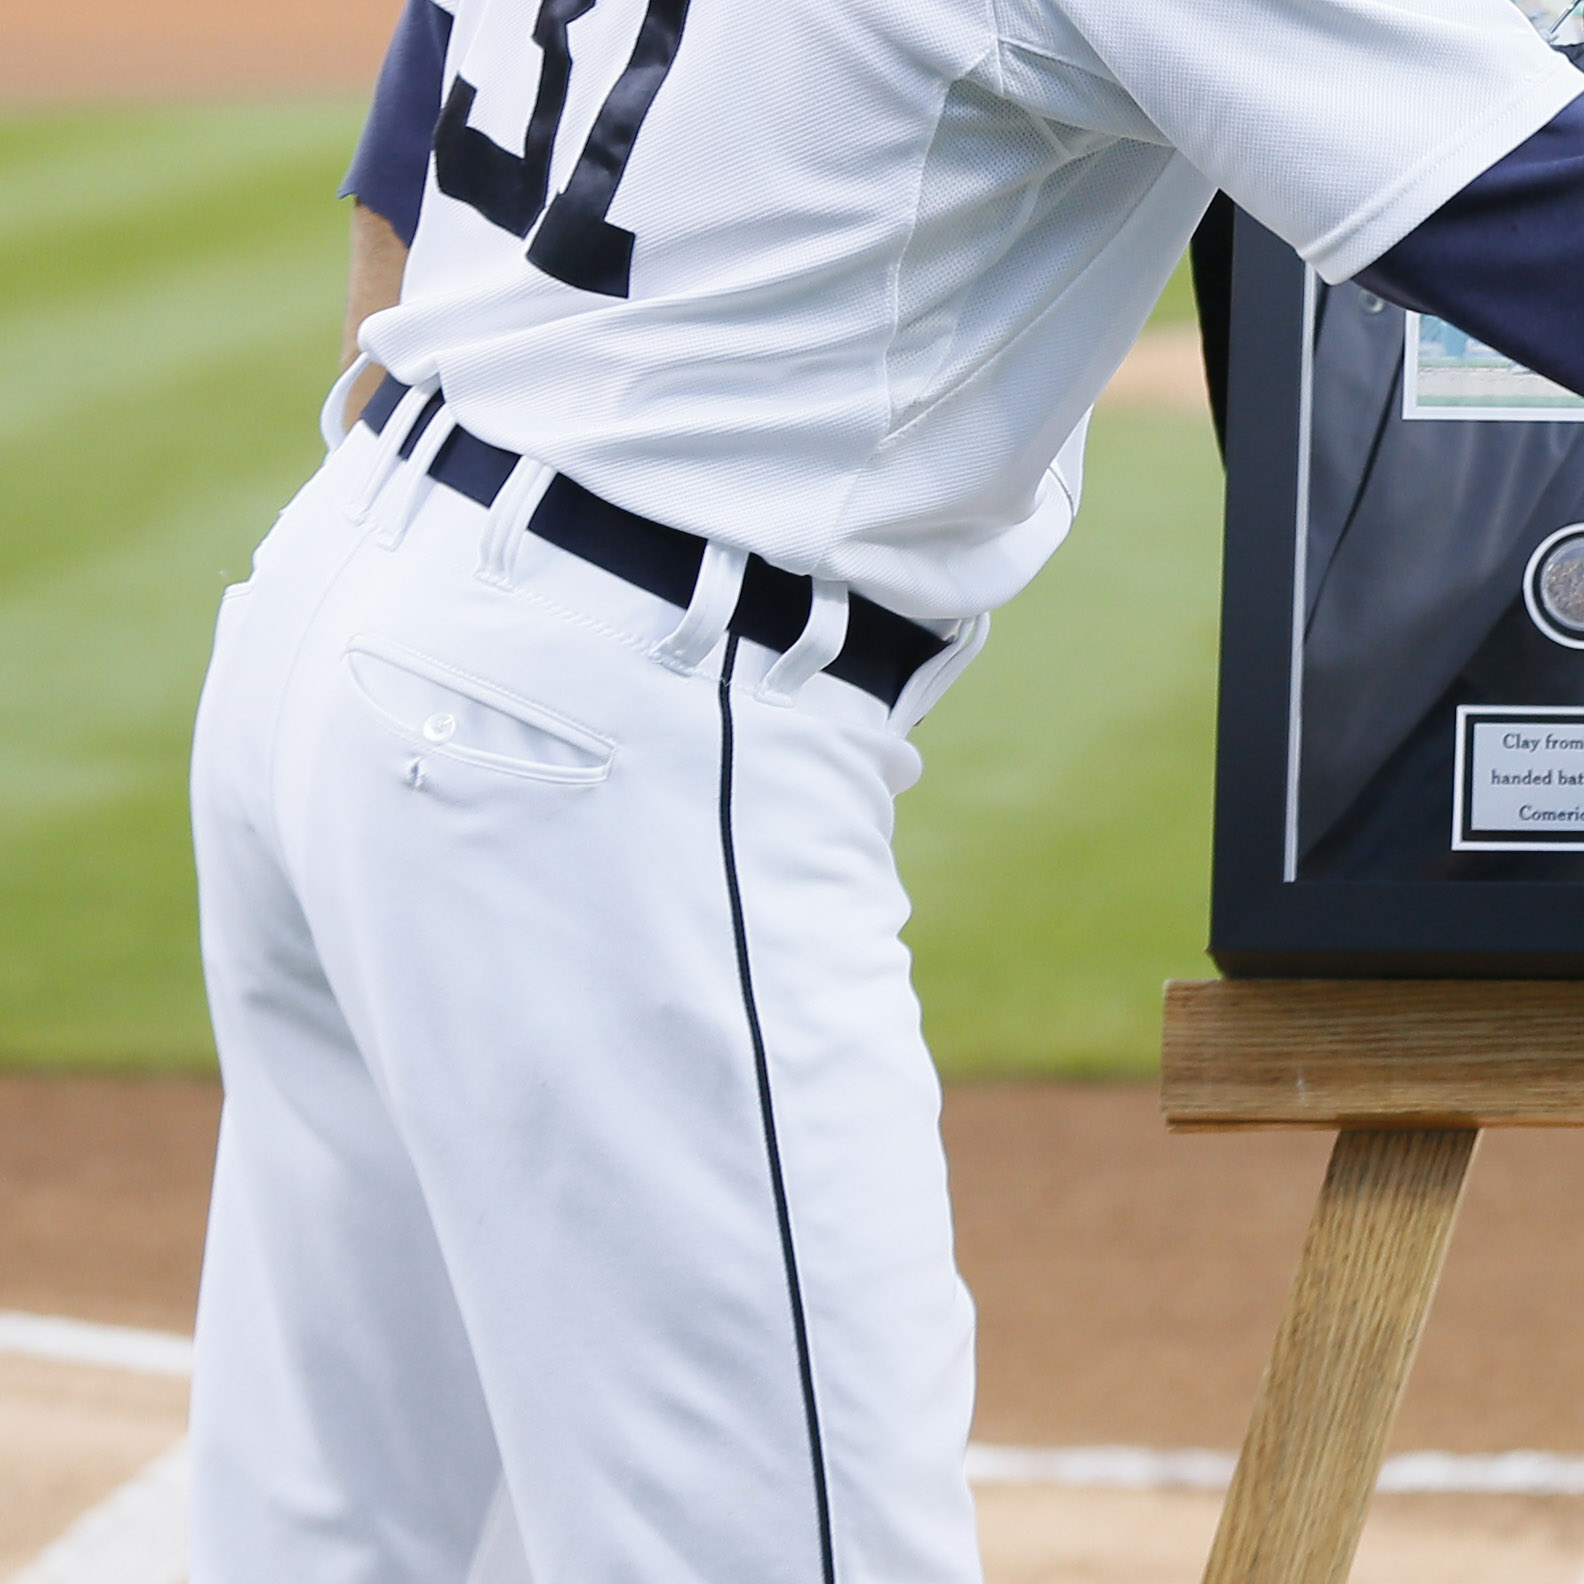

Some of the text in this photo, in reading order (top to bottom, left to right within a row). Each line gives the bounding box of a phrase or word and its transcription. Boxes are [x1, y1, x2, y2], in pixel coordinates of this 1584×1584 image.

[1502, 732, 1541, 753] Clay
[1545, 732, 1584, 750] from
[1491, 769, 1553, 785] handed
